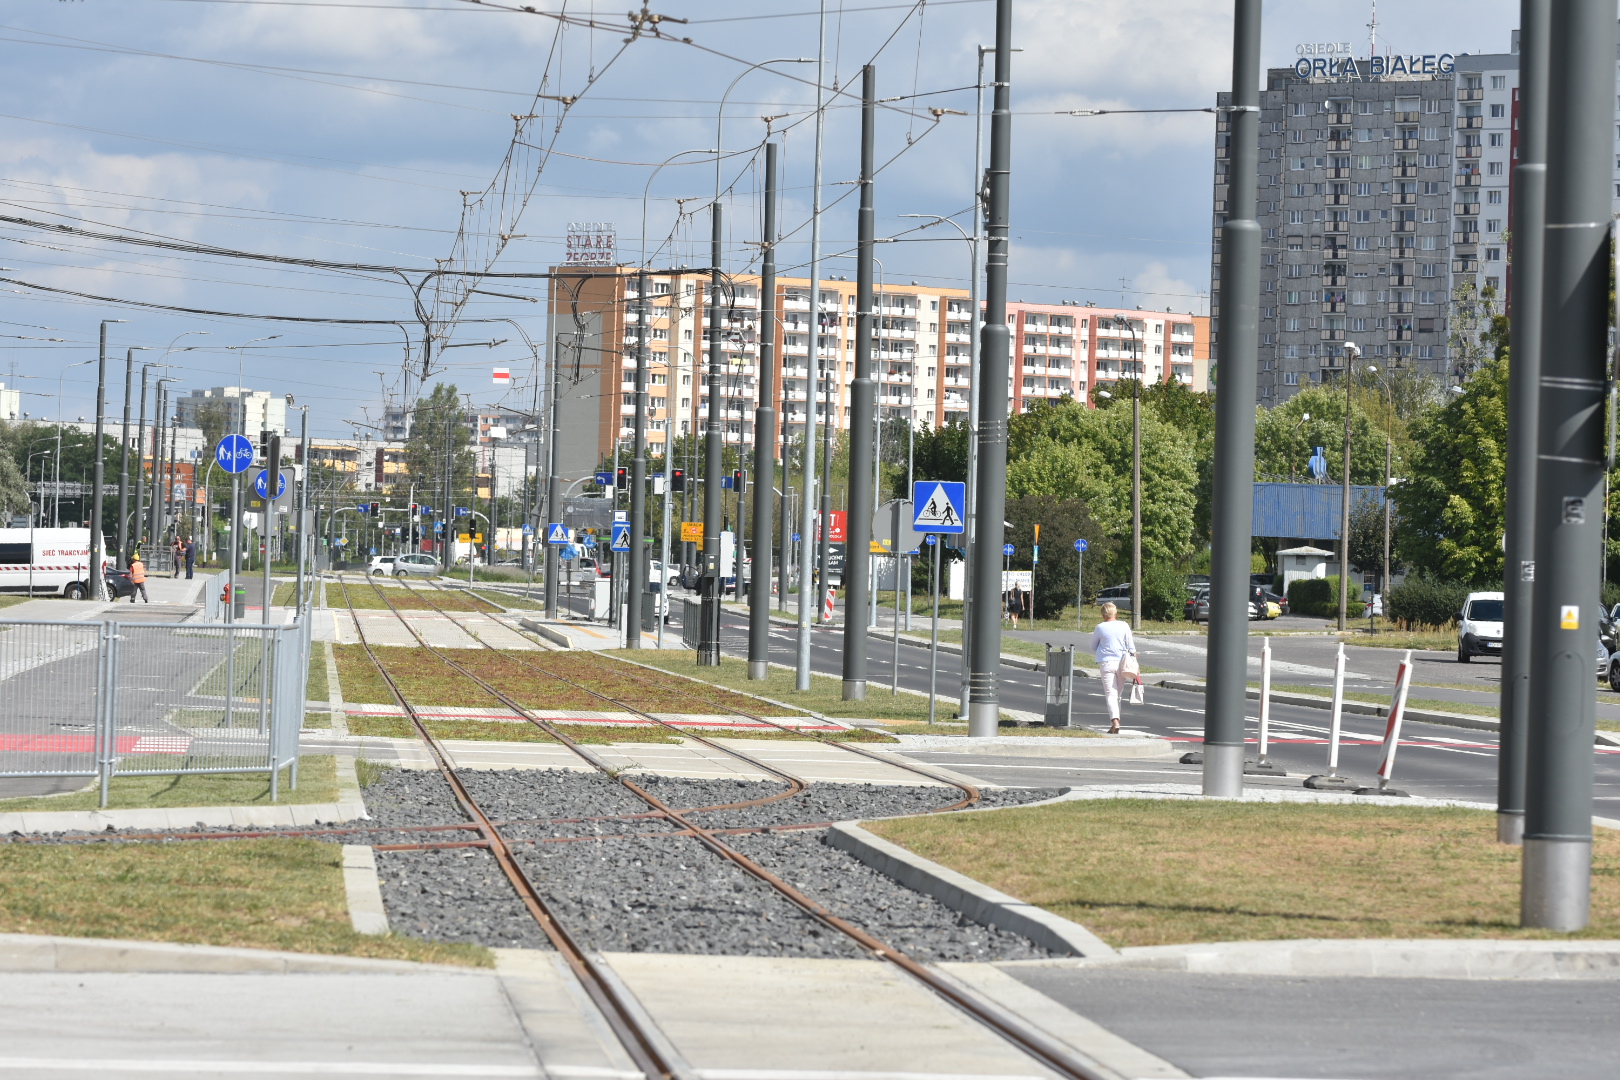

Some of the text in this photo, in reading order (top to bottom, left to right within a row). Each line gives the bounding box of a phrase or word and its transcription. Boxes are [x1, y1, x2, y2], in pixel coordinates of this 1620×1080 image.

[1295, 43, 1351, 55] OSIEDLE
[1295, 52, 1456, 78] ORŁA BIAŁEG
[567, 222, 615, 232] OSIEDLE
[566, 234, 614, 249] STARE
